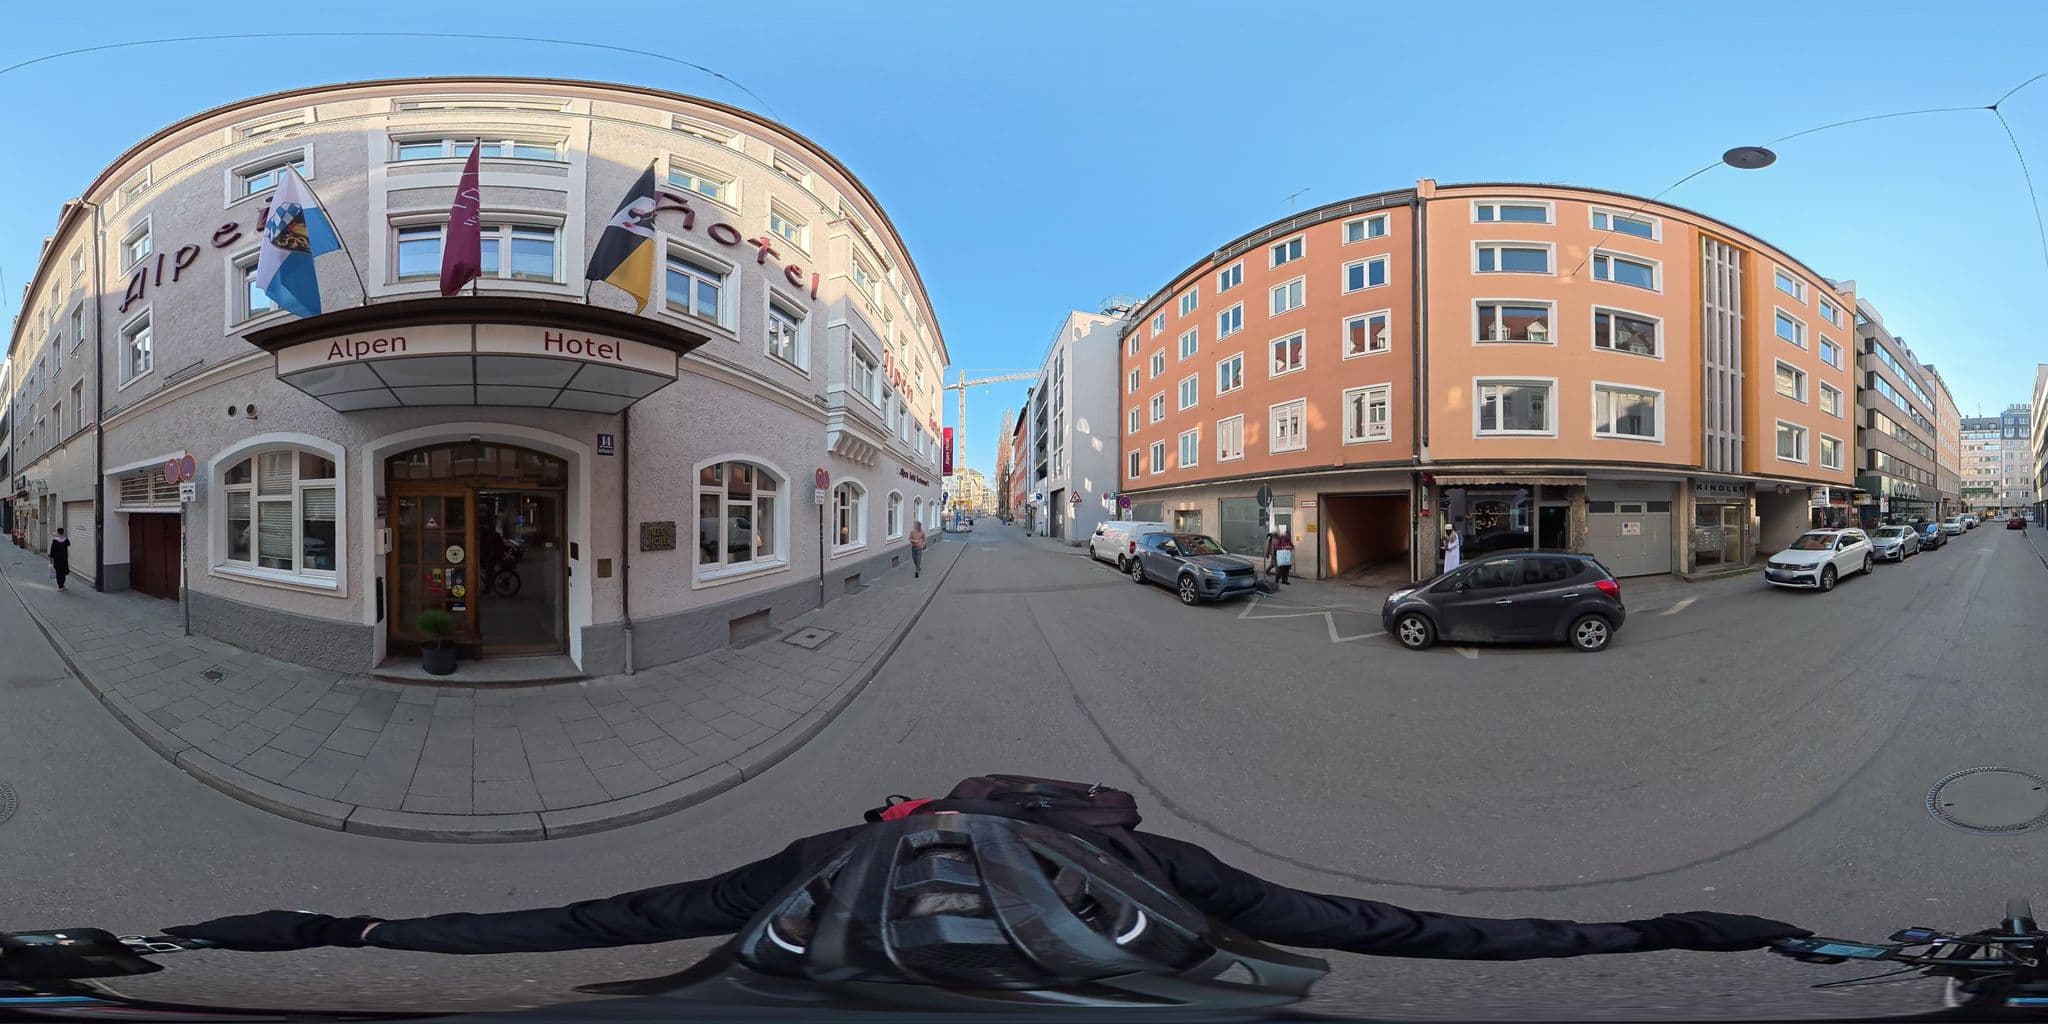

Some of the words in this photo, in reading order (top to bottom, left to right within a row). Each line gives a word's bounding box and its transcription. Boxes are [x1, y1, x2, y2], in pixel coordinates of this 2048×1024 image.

[327, 336, 407, 361] Alpen
[544, 331, 623, 362] Hotel
[1696, 483, 1746, 493] KINDLER
